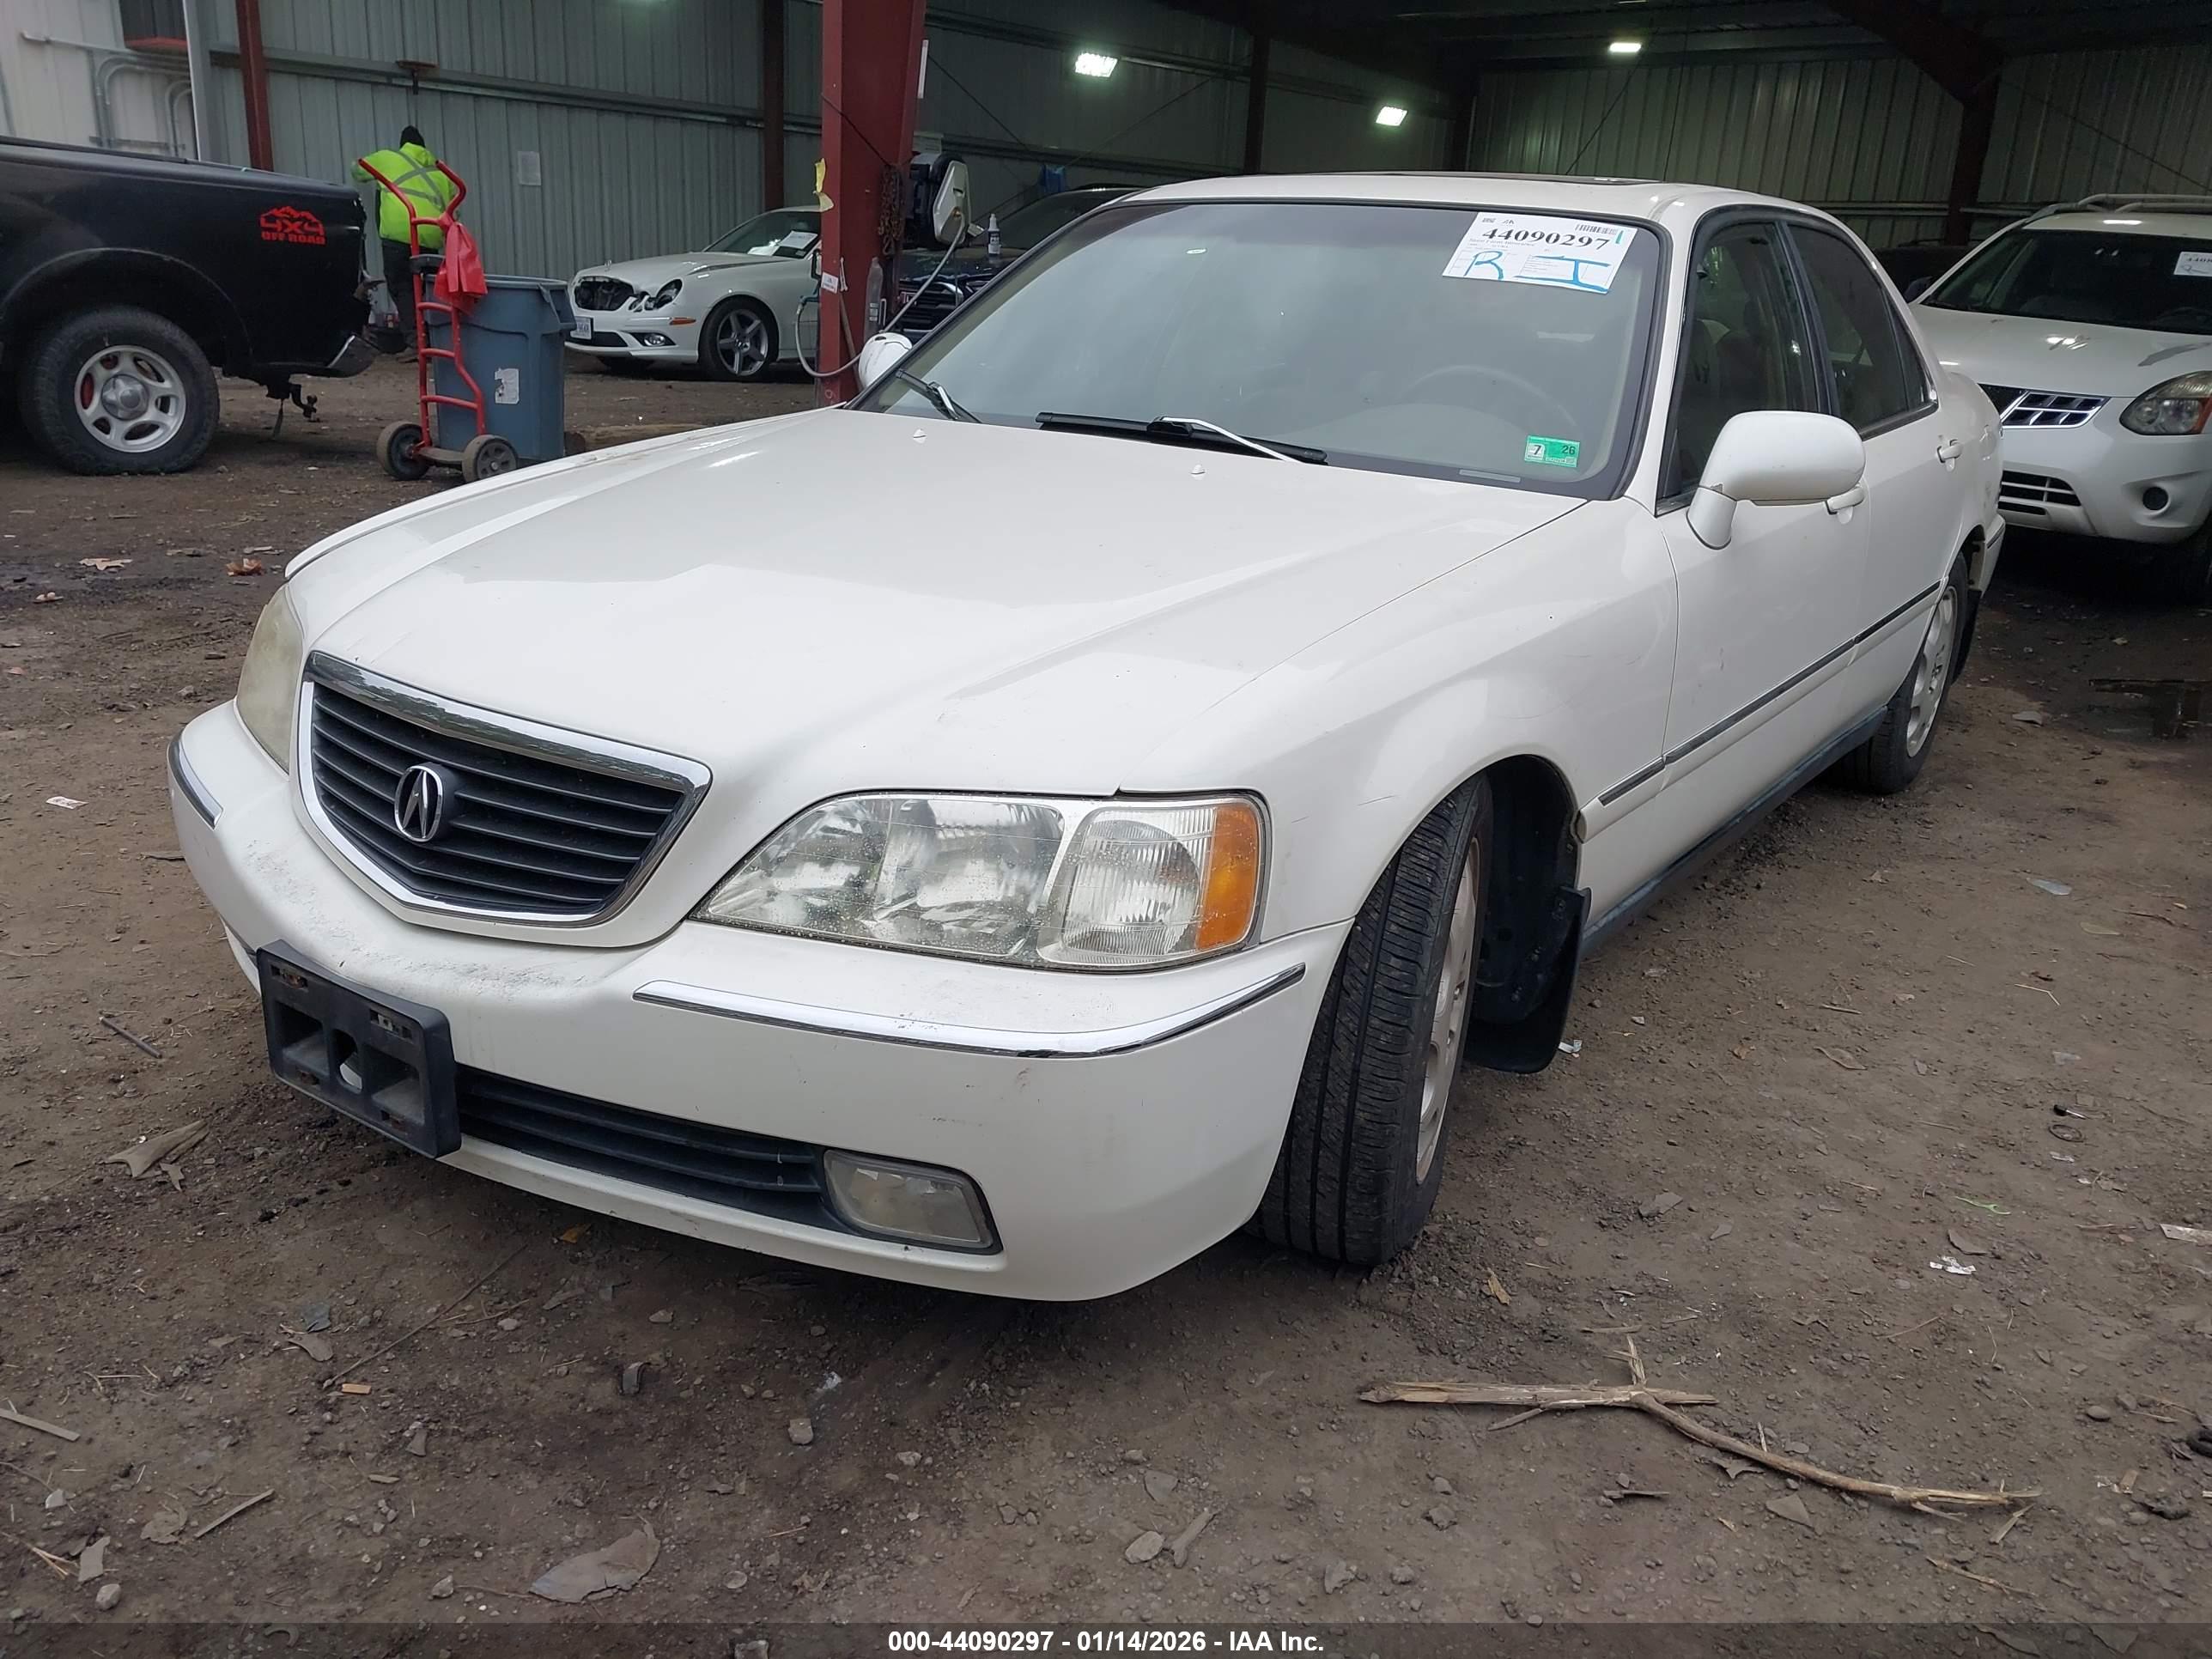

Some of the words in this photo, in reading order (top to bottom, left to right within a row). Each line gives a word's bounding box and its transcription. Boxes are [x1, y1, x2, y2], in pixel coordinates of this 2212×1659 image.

[261, 231, 286, 240] OFF
[288, 234, 326, 245] ROAD
[1482, 228, 1611, 250] 44090297
[1463, 251, 1504, 281] R
[1533, 444, 1542, 455] 7
[1562, 445, 1576, 455] 26
